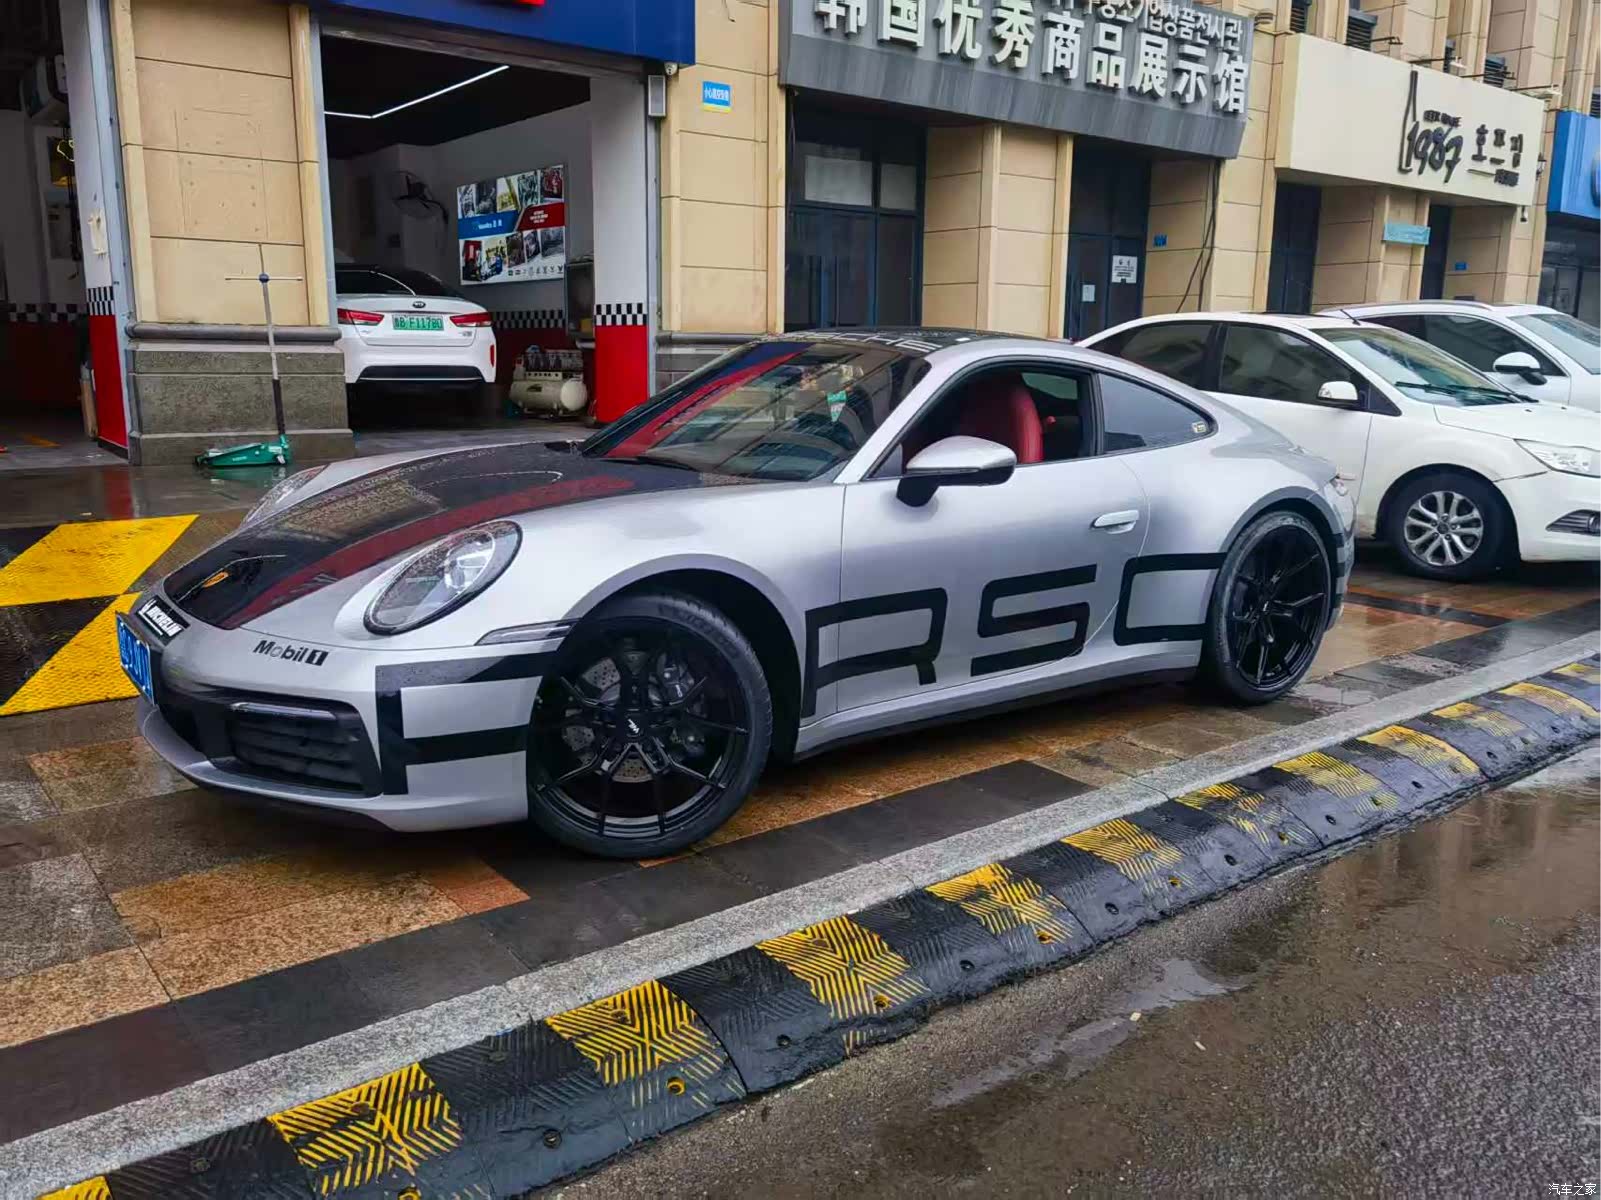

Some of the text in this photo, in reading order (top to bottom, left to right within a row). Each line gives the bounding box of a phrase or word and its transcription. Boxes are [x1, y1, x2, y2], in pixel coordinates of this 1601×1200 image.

[1405, 120, 1463, 183] 1987
[146, 605, 182, 637] MICHELIN
[253, 640, 308, 662] Mobil
